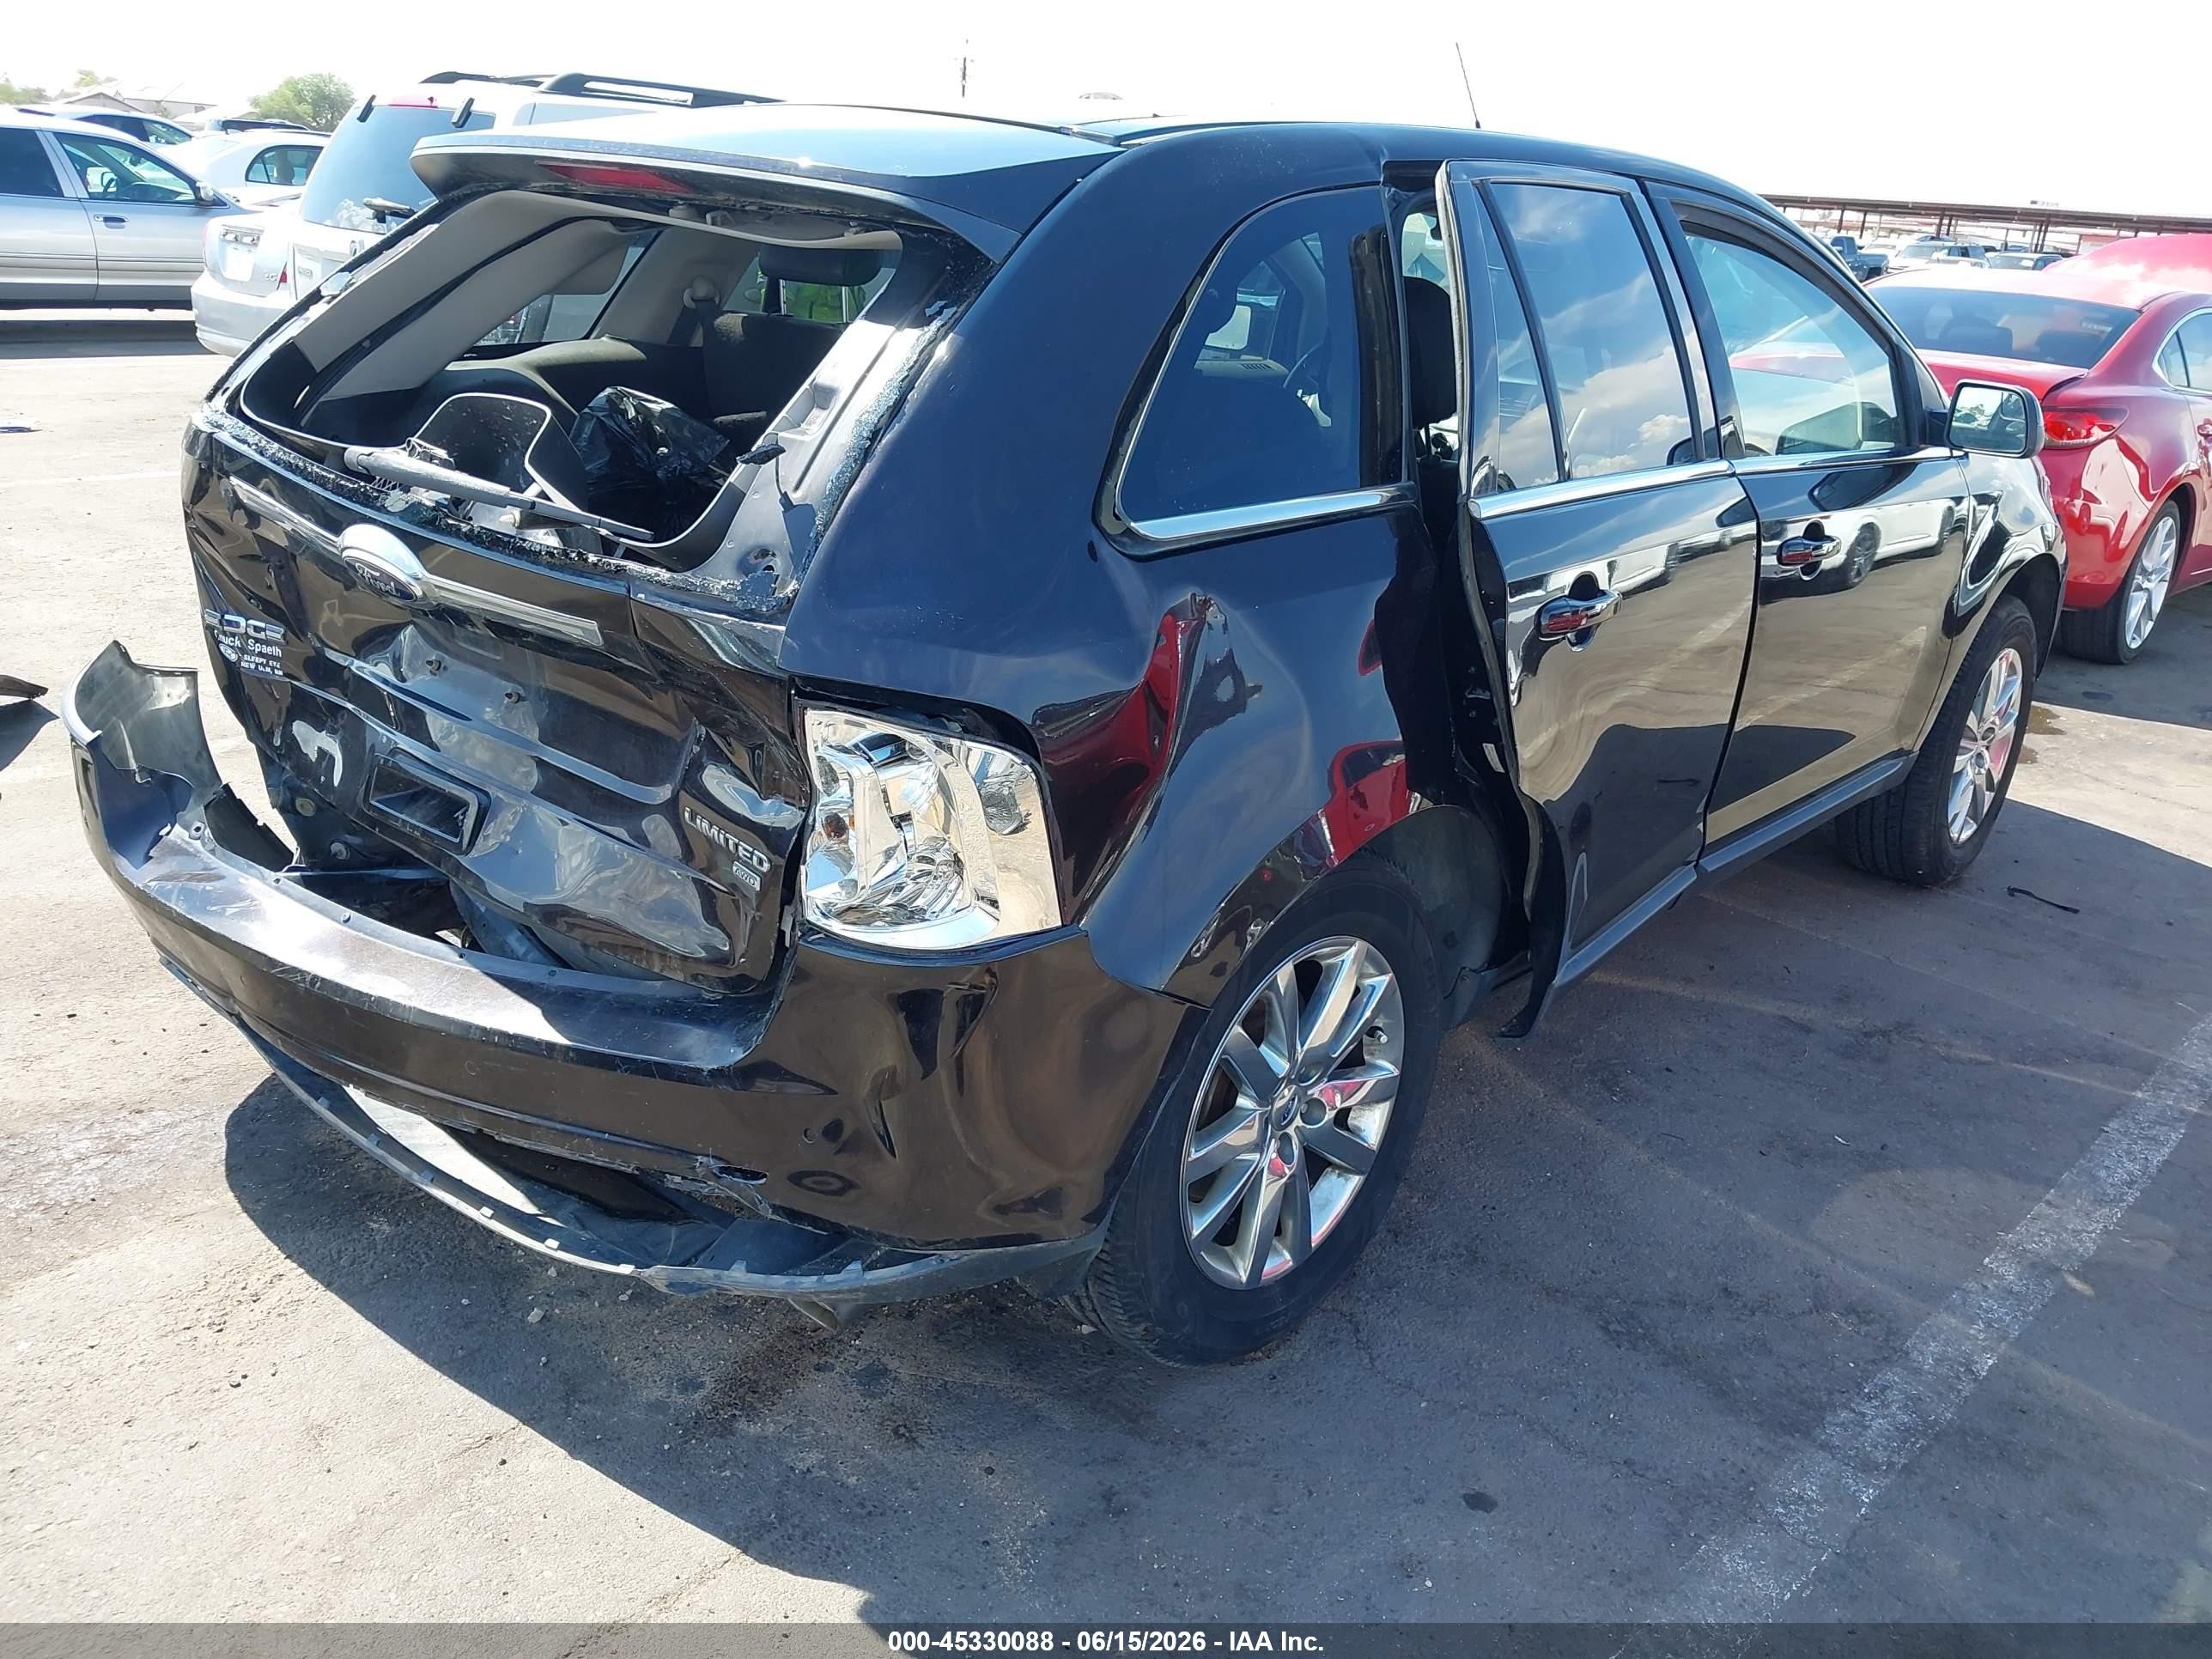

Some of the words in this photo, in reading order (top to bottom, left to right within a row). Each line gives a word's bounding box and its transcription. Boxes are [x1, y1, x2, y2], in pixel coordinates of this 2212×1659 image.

[355, 562, 401, 598] Ford
[204, 608, 287, 643] EDGE
[683, 806, 772, 873] LIMITED
[734, 867, 757, 887] AWD
